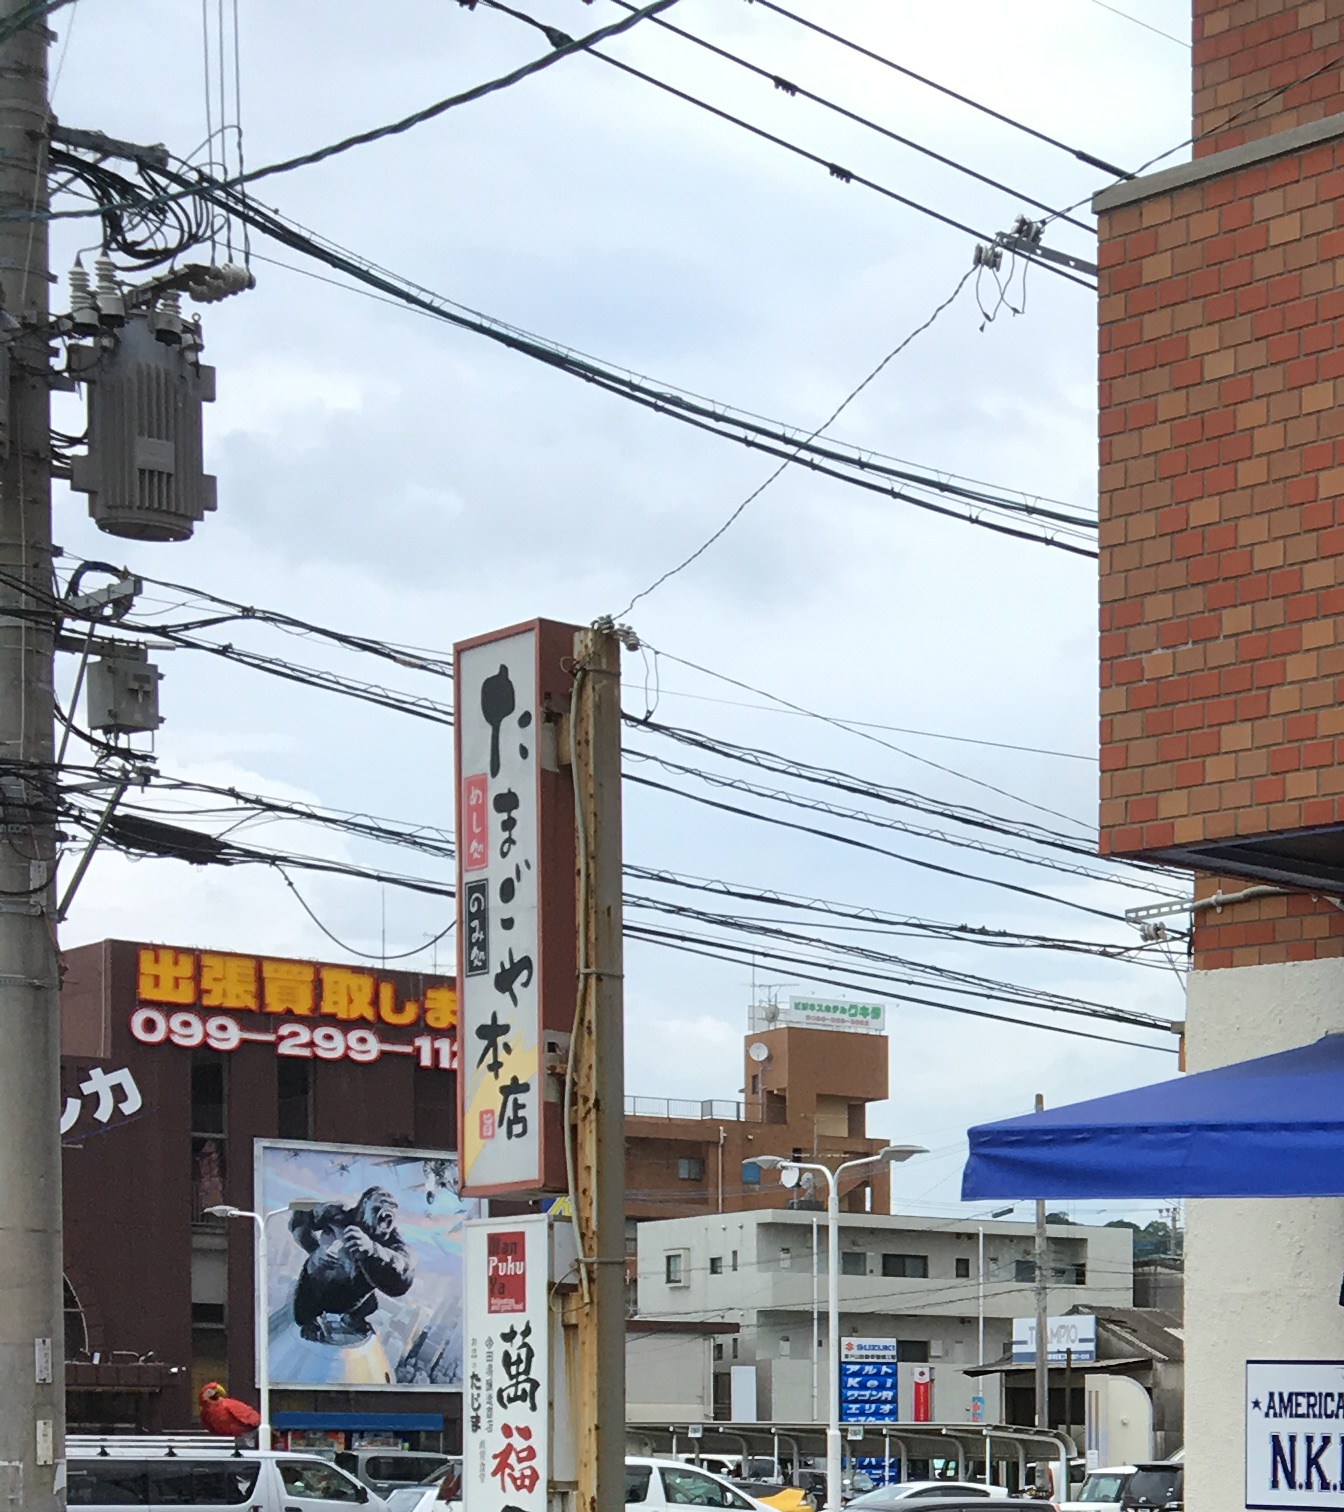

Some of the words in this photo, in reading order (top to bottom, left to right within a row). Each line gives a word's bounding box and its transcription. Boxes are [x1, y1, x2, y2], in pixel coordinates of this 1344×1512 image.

[131, 1007, 457, 1070] 099-299-11
[846, 1365, 893, 1375] アルト
